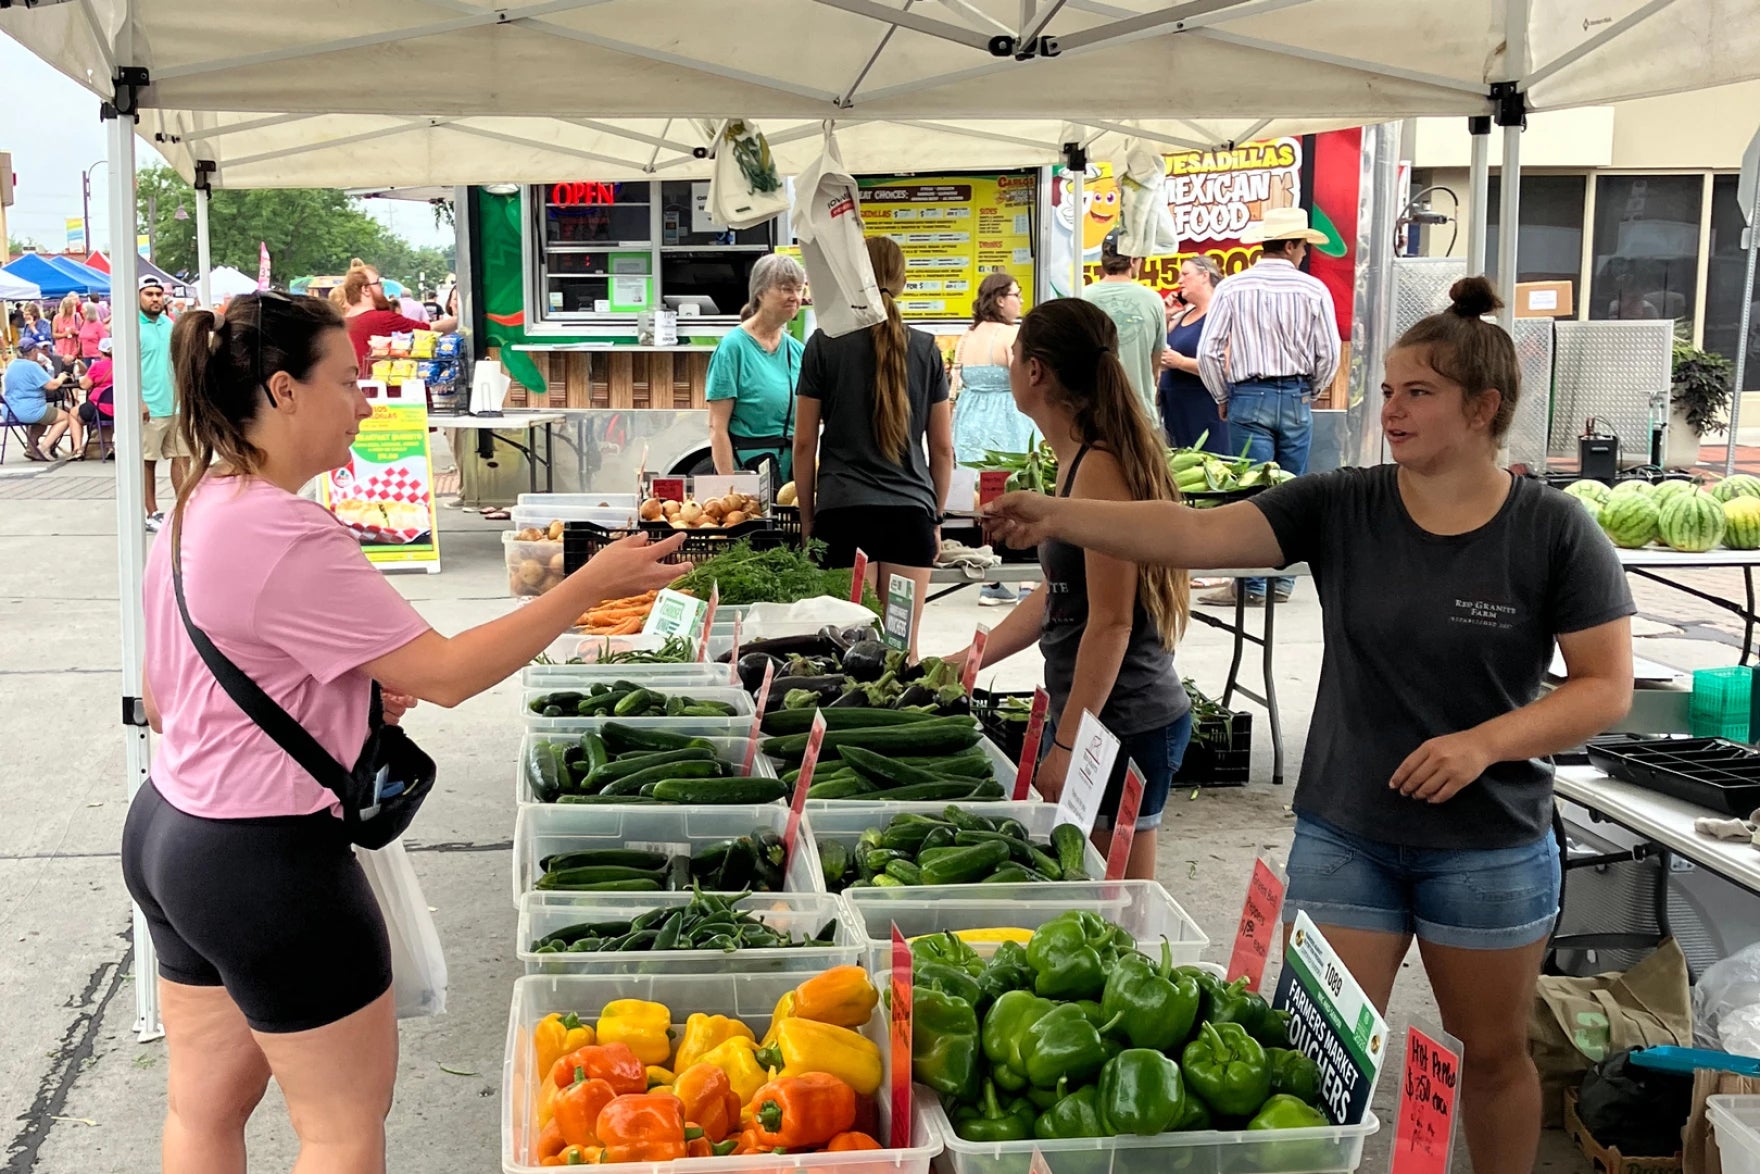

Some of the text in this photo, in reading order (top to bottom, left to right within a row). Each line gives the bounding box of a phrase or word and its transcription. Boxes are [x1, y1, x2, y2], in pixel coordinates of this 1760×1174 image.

[552, 181, 615, 208] OPEN
[1174, 200, 1253, 236] FOOD
[1324, 962, 1343, 997] 1089
[1289, 978, 1327, 1042] FARMERS
[1323, 1029, 1359, 1091] MARKET
[1284, 998, 1351, 1125] OUCHERS
